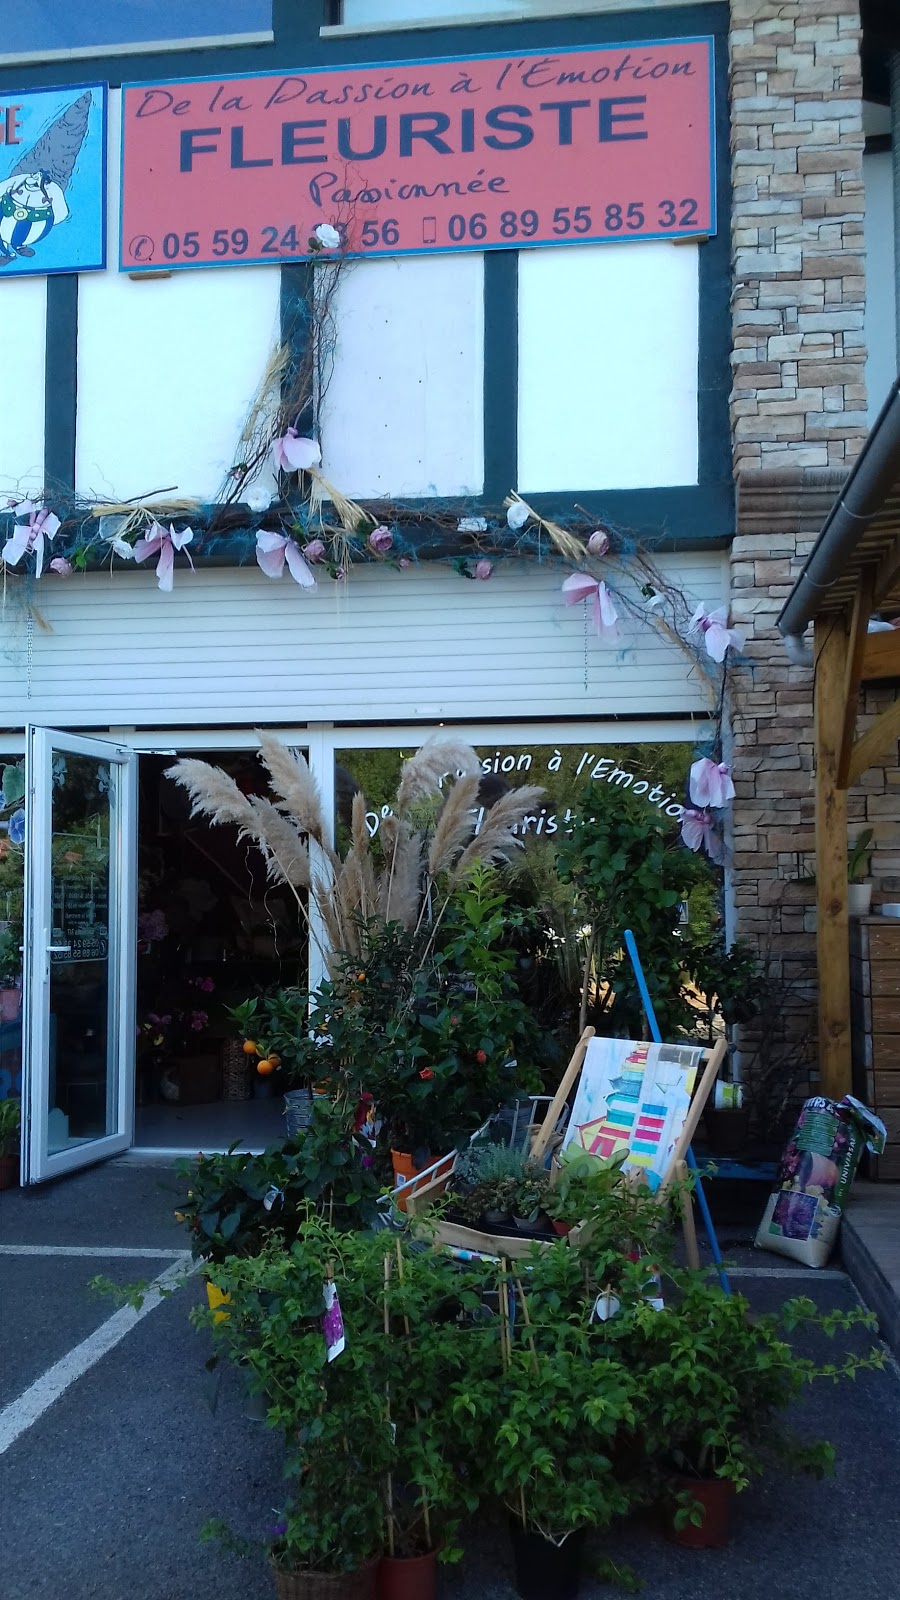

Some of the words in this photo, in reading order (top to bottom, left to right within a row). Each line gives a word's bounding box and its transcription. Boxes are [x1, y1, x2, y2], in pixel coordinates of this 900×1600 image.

[136, 89, 192, 118] De
[208, 85, 253, 113] la
[263, 77, 435, 110] Passion
[449, 72, 482, 94] à
[179, 95, 649, 173] FLEURISTE
[308, 168, 511, 208] Passionnée
[162, 231, 201, 259] 05
[212, 228, 249, 256] 59
[260, 225, 300, 253] 24
[361, 218, 400, 247] 56
[448, 213, 488, 242] 06
[499, 210, 539, 238] 89
[552, 206, 592, 235] 55
[604, 202, 645, 230] 85
[657, 198, 699, 228] 32
[547, 749, 562, 772] à
[575, 751, 687, 824] l'Emotio
